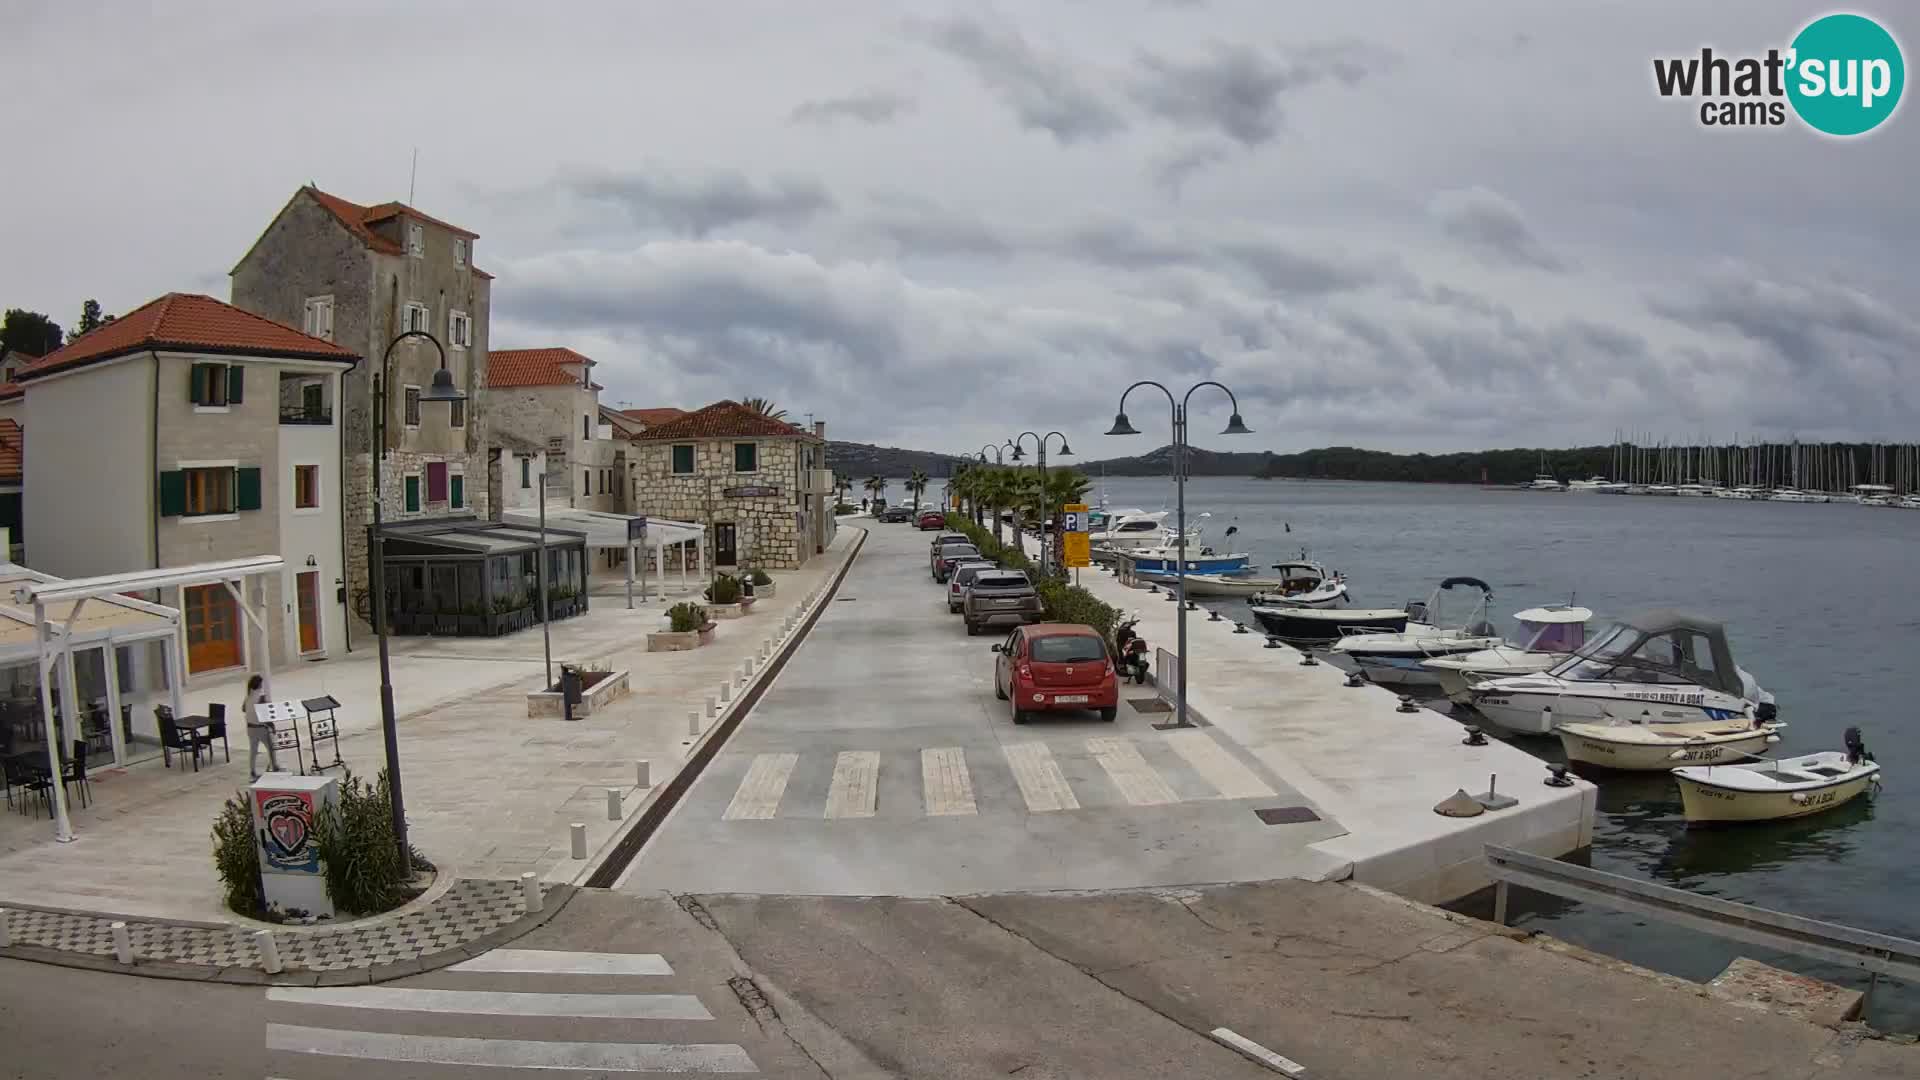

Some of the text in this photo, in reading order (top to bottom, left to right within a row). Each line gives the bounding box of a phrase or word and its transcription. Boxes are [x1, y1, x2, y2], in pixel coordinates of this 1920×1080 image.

[1066, 514, 1076, 530] P
[1660, 693, 1679, 703] RENT
[1686, 693, 1704, 705] BOAT
[1705, 748, 1723, 760] BOAT
[1821, 792, 1836, 804] BOAT
